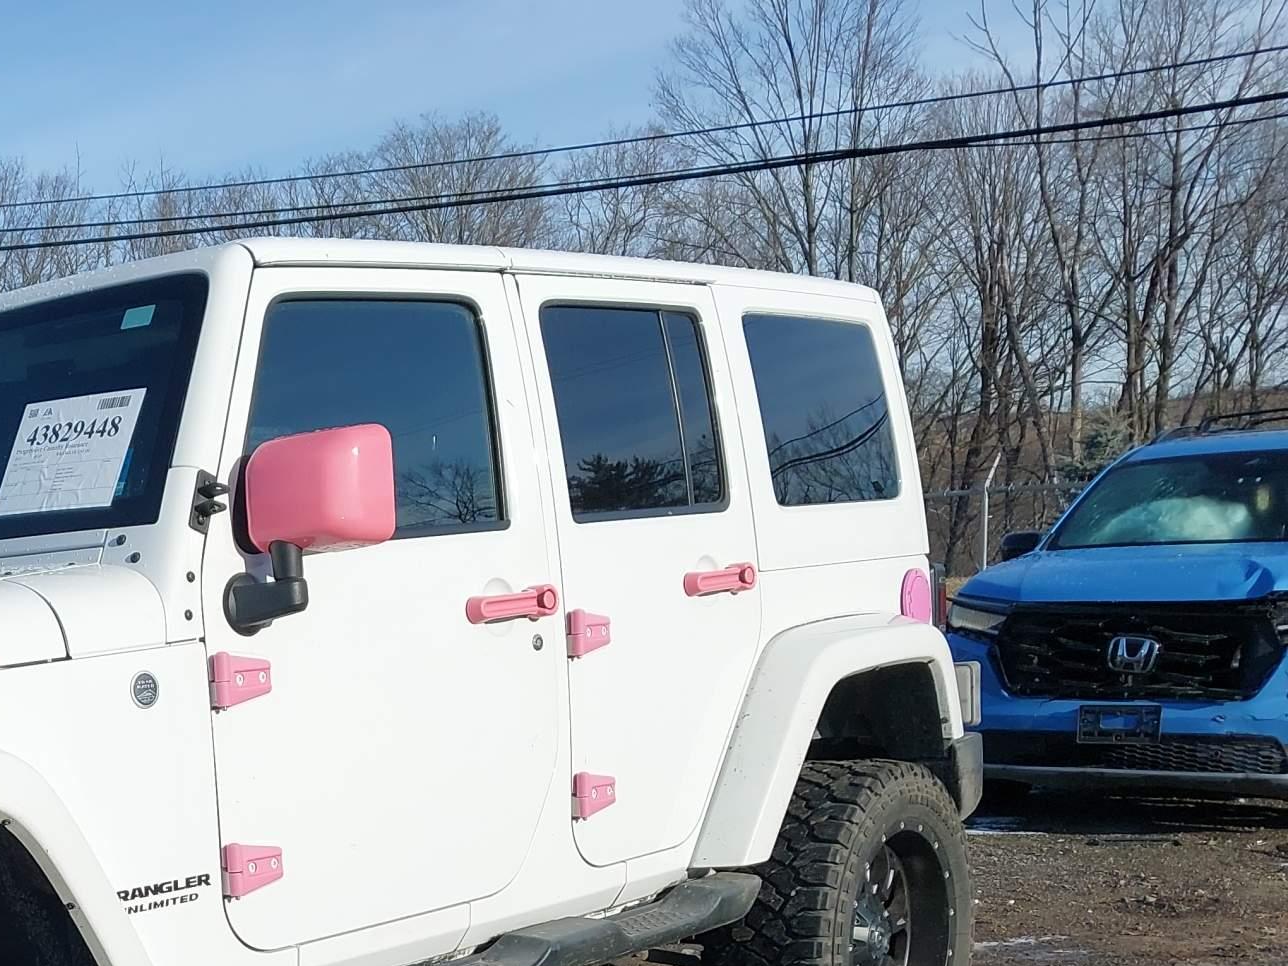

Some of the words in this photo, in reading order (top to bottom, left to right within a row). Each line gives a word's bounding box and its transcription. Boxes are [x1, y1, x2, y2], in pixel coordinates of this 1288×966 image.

[26, 415, 123, 447] 43829448
[116, 873, 212, 902] RANGLER
[124, 893, 199, 915] NLIMITED
